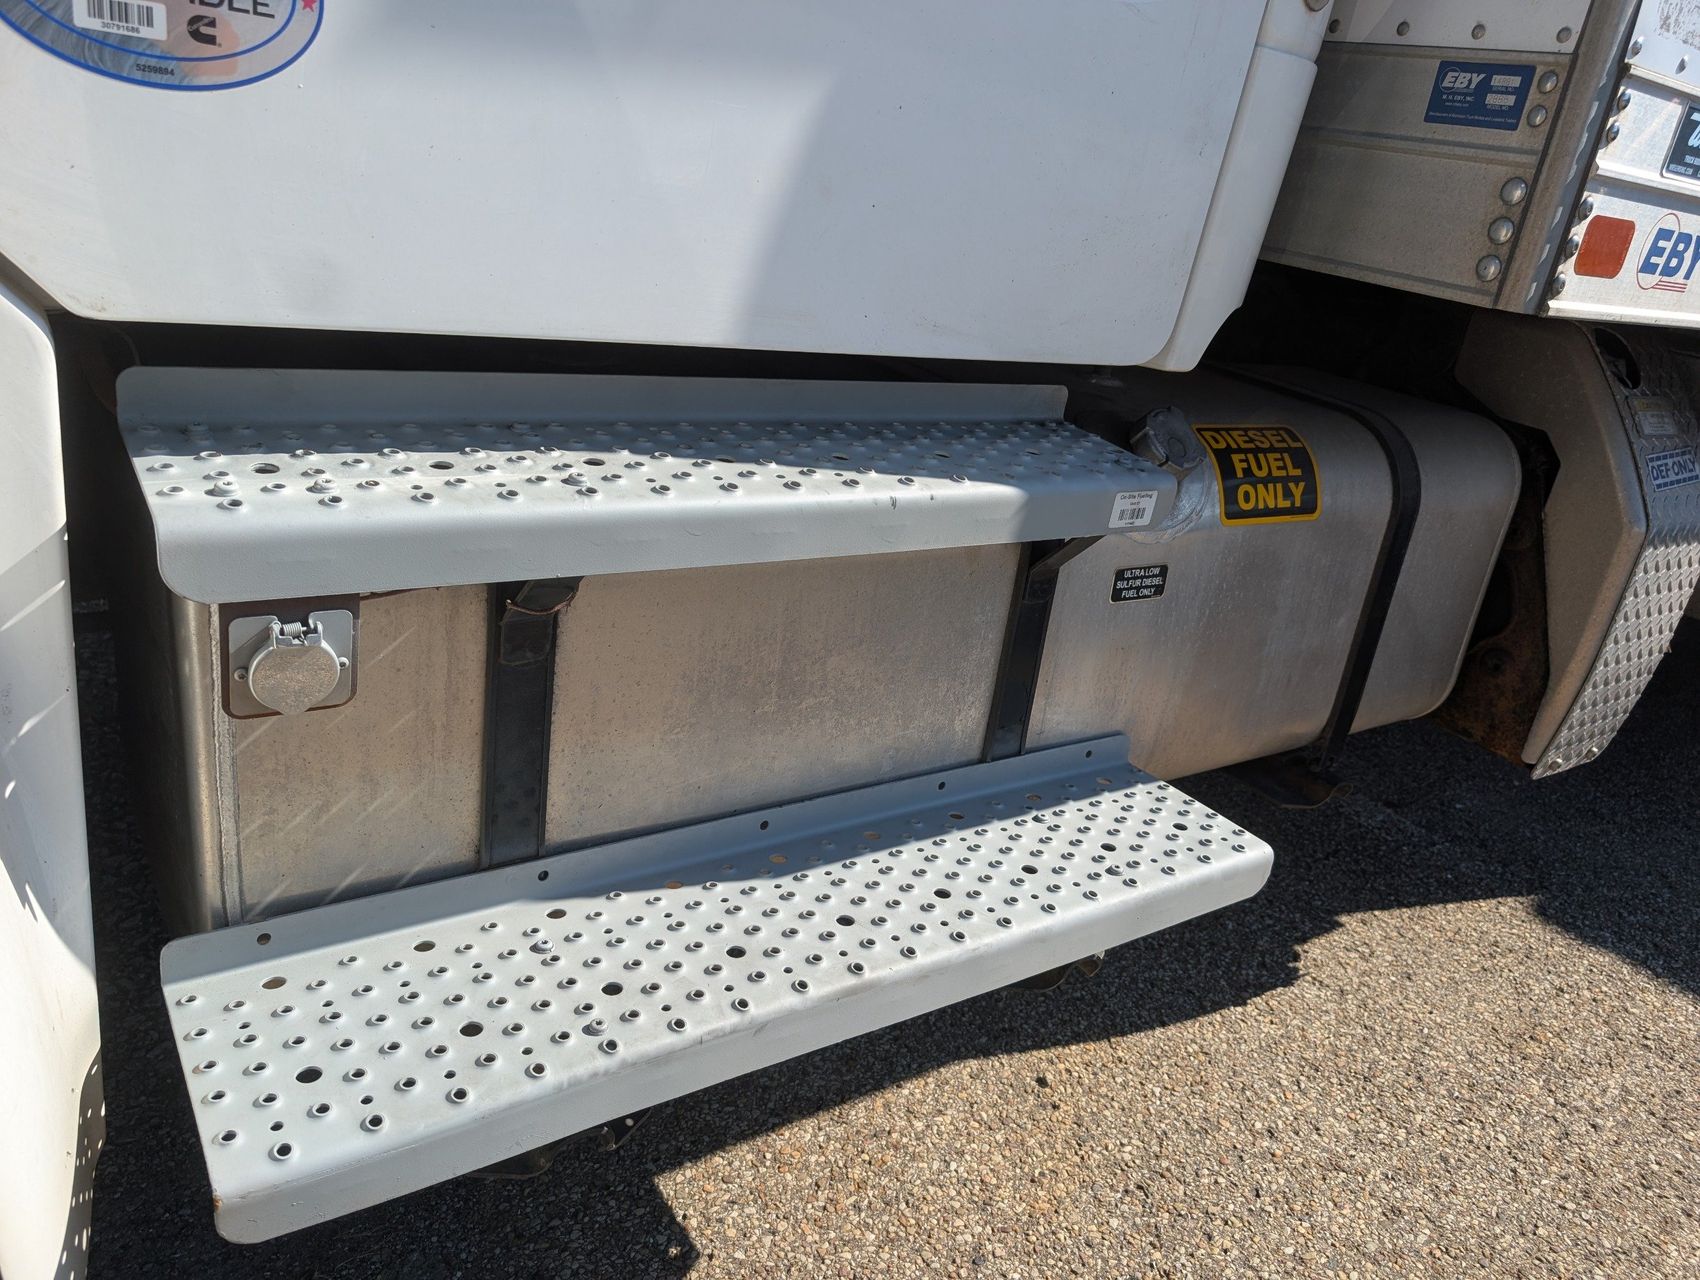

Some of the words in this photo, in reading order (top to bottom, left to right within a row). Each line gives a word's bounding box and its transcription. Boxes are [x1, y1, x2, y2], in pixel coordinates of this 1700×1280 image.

[135, 63, 176, 77] 5259894
[1442, 72, 1487, 88] EBY
[1199, 430, 1304, 449] DIESEL
[1231, 453, 1302, 478] FUEL
[1650, 462, 1671, 481] DEF
[1671, 457, 1697, 477] ONLY
[1237, 481, 1306, 511] ONLY
[1123, 568, 1145, 578] ULTRA
[1145, 566, 1161, 576] LOW
[1115, 579, 1142, 589] SULFUR
[1142, 576, 1164, 587] DIESEL
[1121, 589, 1138, 599] FUEL
[1138, 587, 1156, 597] ONLY
